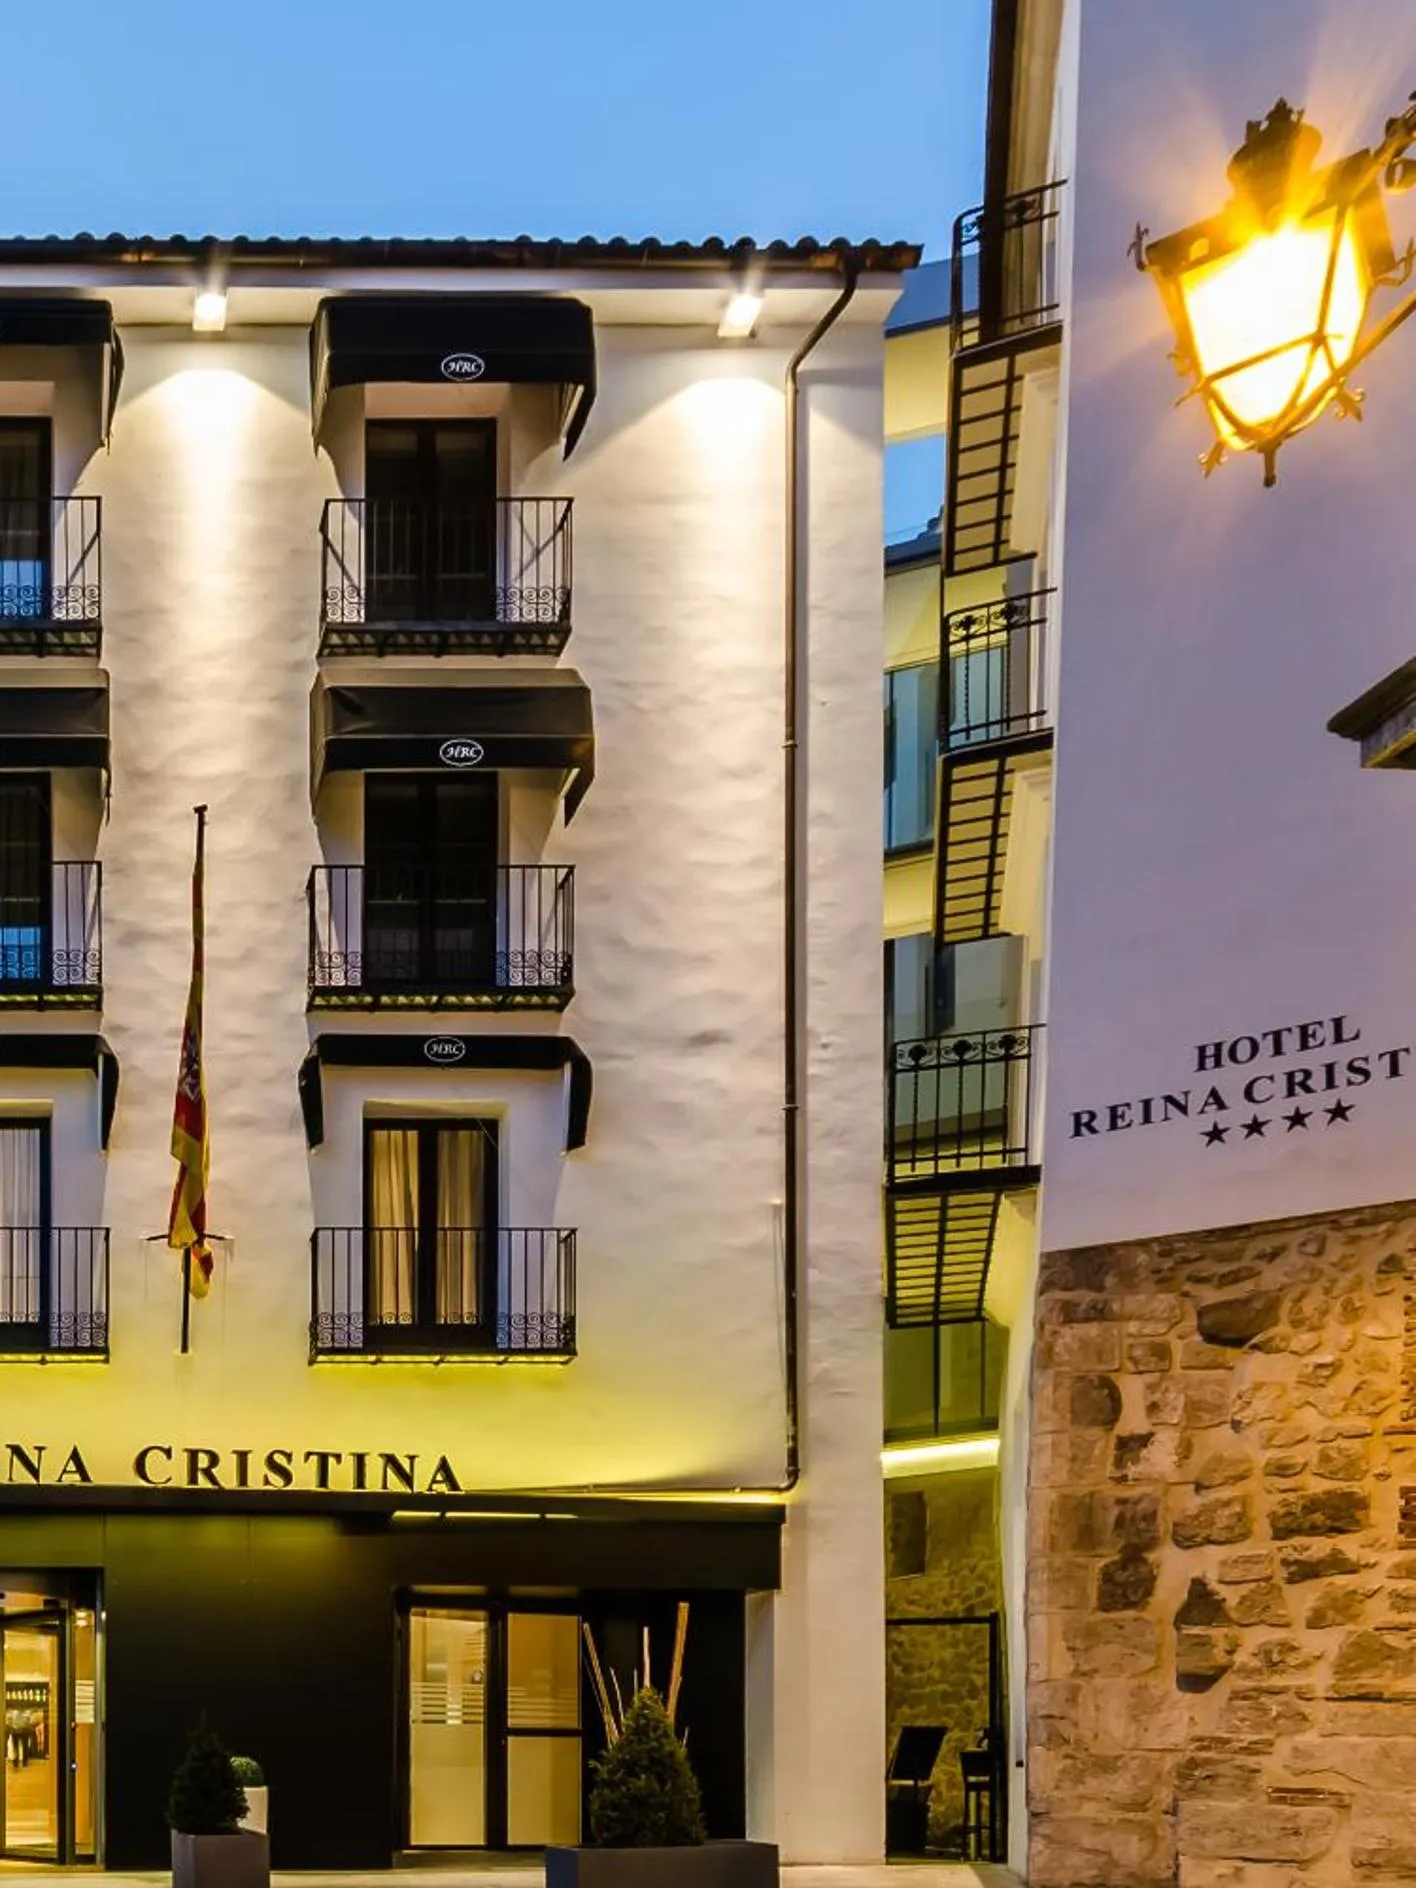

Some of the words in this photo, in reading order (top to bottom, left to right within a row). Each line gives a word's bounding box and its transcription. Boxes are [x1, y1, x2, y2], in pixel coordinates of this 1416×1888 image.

[447, 360, 477, 373] HRC
[446, 746, 478, 758] HRC
[430, 1042, 460, 1054] HRC
[1194, 1015, 1361, 1072] HOTEL
[1069, 1086, 1230, 1138] REINA
[1243, 1047, 1411, 1104] CRIST
[133, 1445, 462, 1493] CRISTINA
